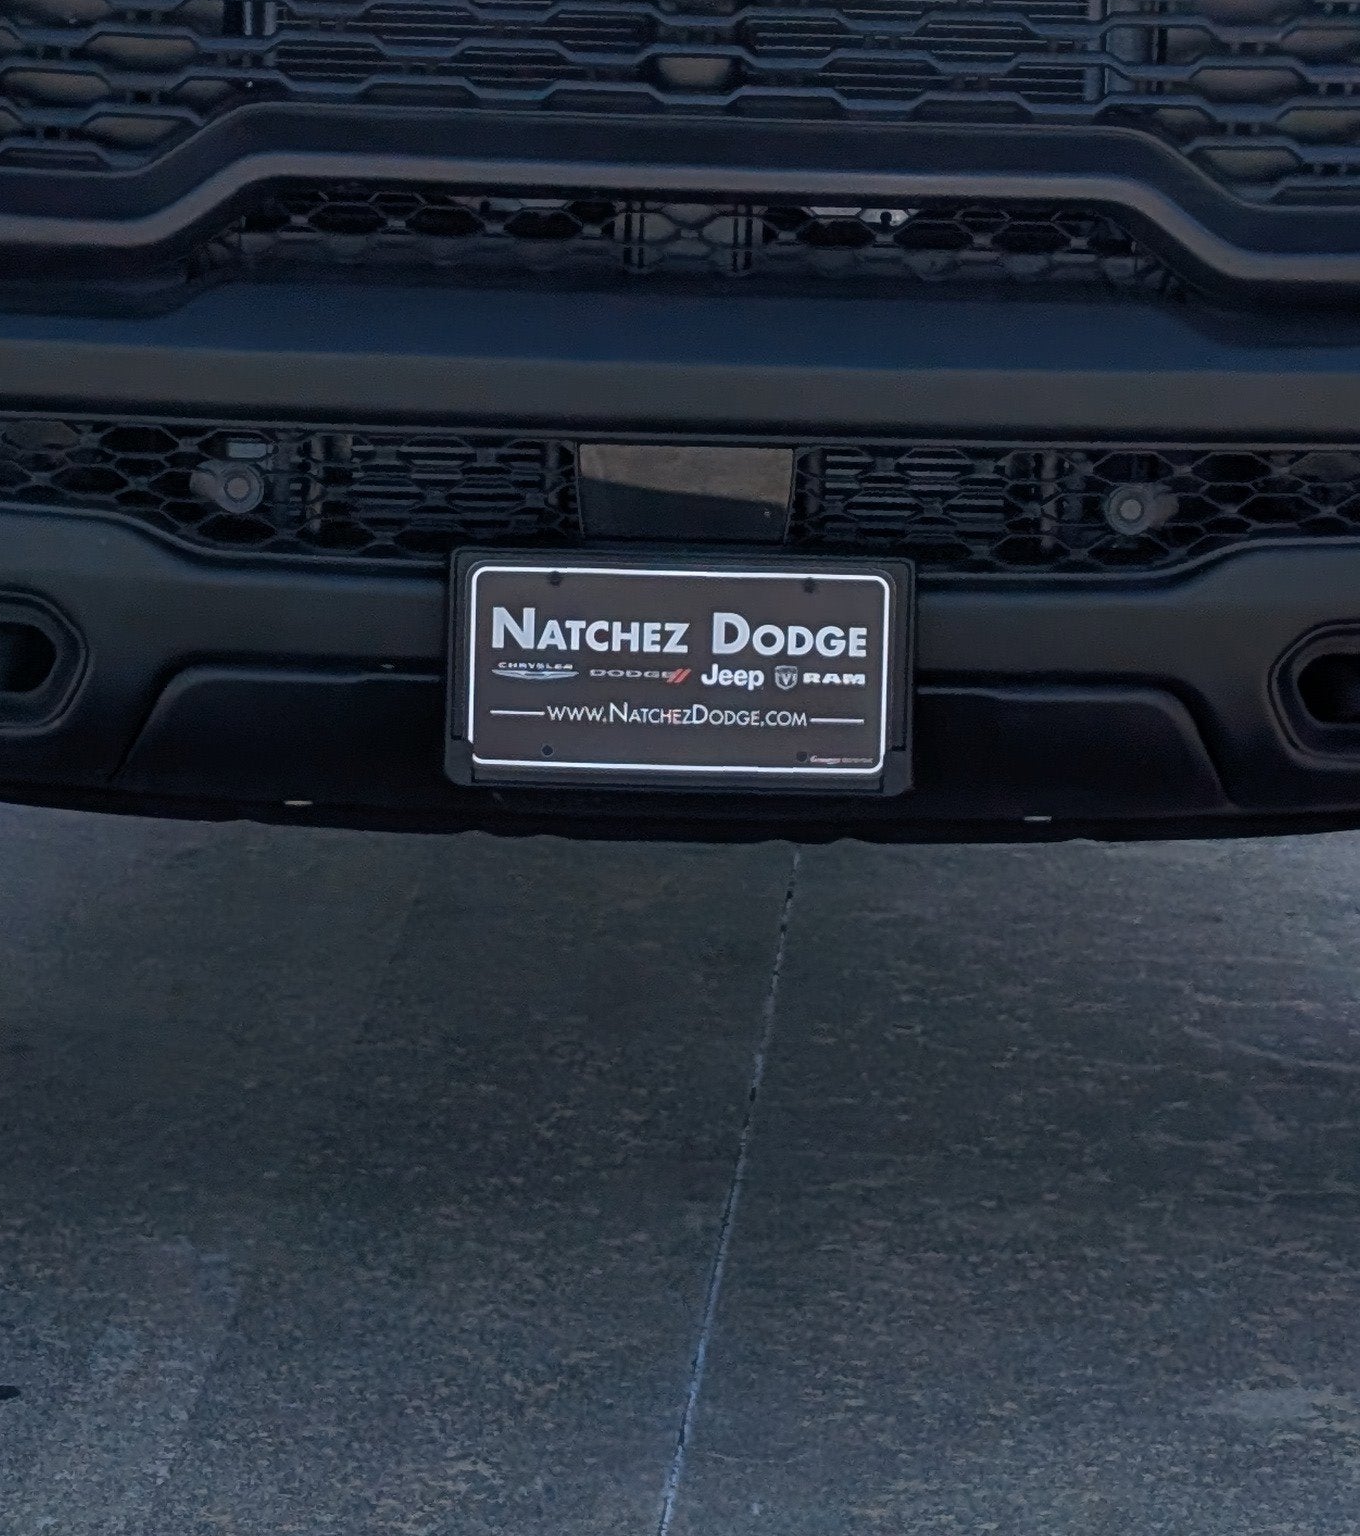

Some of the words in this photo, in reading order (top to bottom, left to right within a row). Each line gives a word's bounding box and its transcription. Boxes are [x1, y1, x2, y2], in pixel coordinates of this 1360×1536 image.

[712, 612, 868, 658] DODGE
[497, 661, 574, 670] CHRYSLER
[589, 668, 674, 679] DODGE
[701, 664, 765, 691] Jeep
[802, 672, 866, 686] RAM
